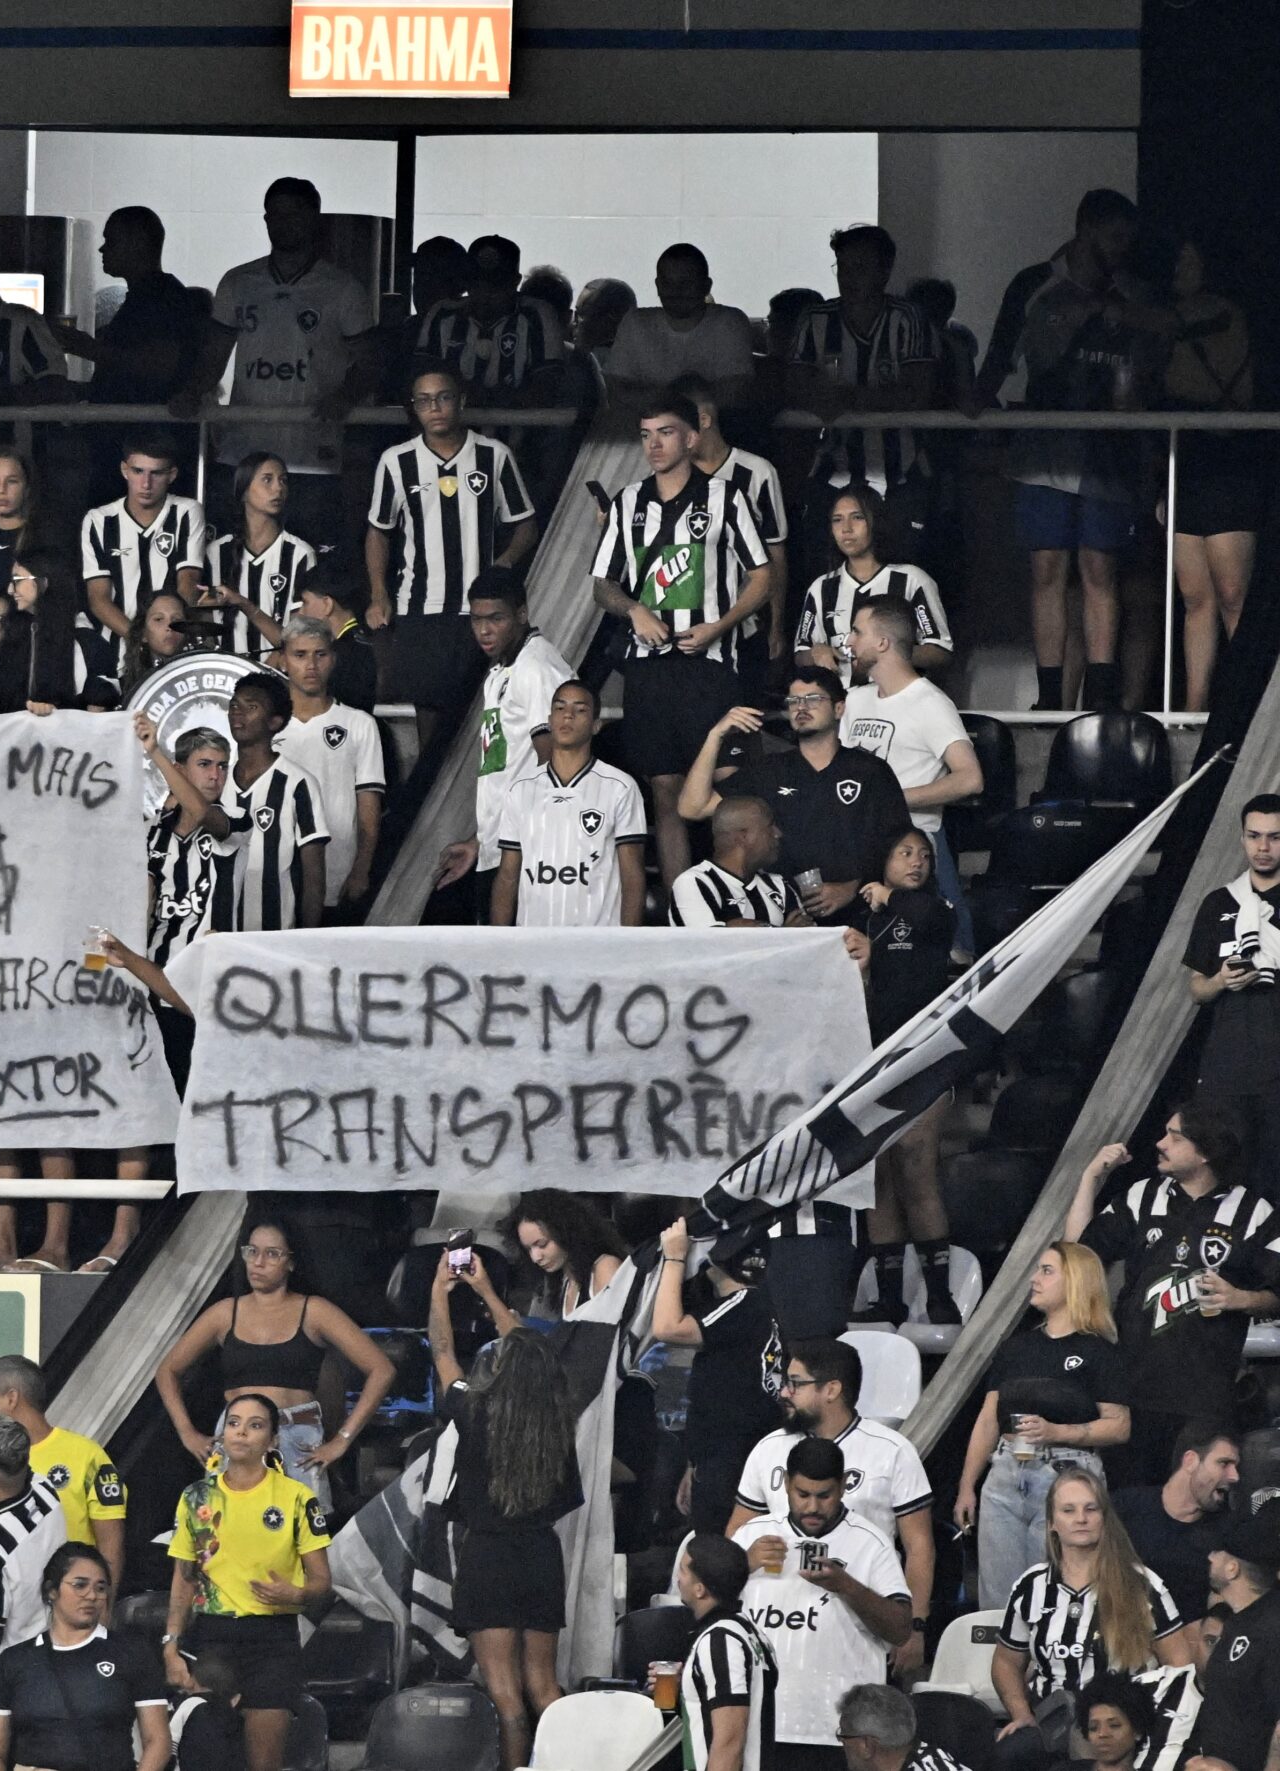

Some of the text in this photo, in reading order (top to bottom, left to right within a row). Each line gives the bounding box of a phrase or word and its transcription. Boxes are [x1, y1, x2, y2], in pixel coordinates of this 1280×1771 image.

[301, 15, 500, 82] BRAHMA
[174, 675, 200, 697] DE
[202, 673, 237, 693] GEN
[6, 742, 120, 810] MAIS
[524, 860, 590, 886] vbet
[157, 891, 203, 919] bet
[214, 964, 751, 1067] QUEREMOS
[749, 1604, 819, 1632] vbet
[1040, 1641, 1095, 1659] vbe
